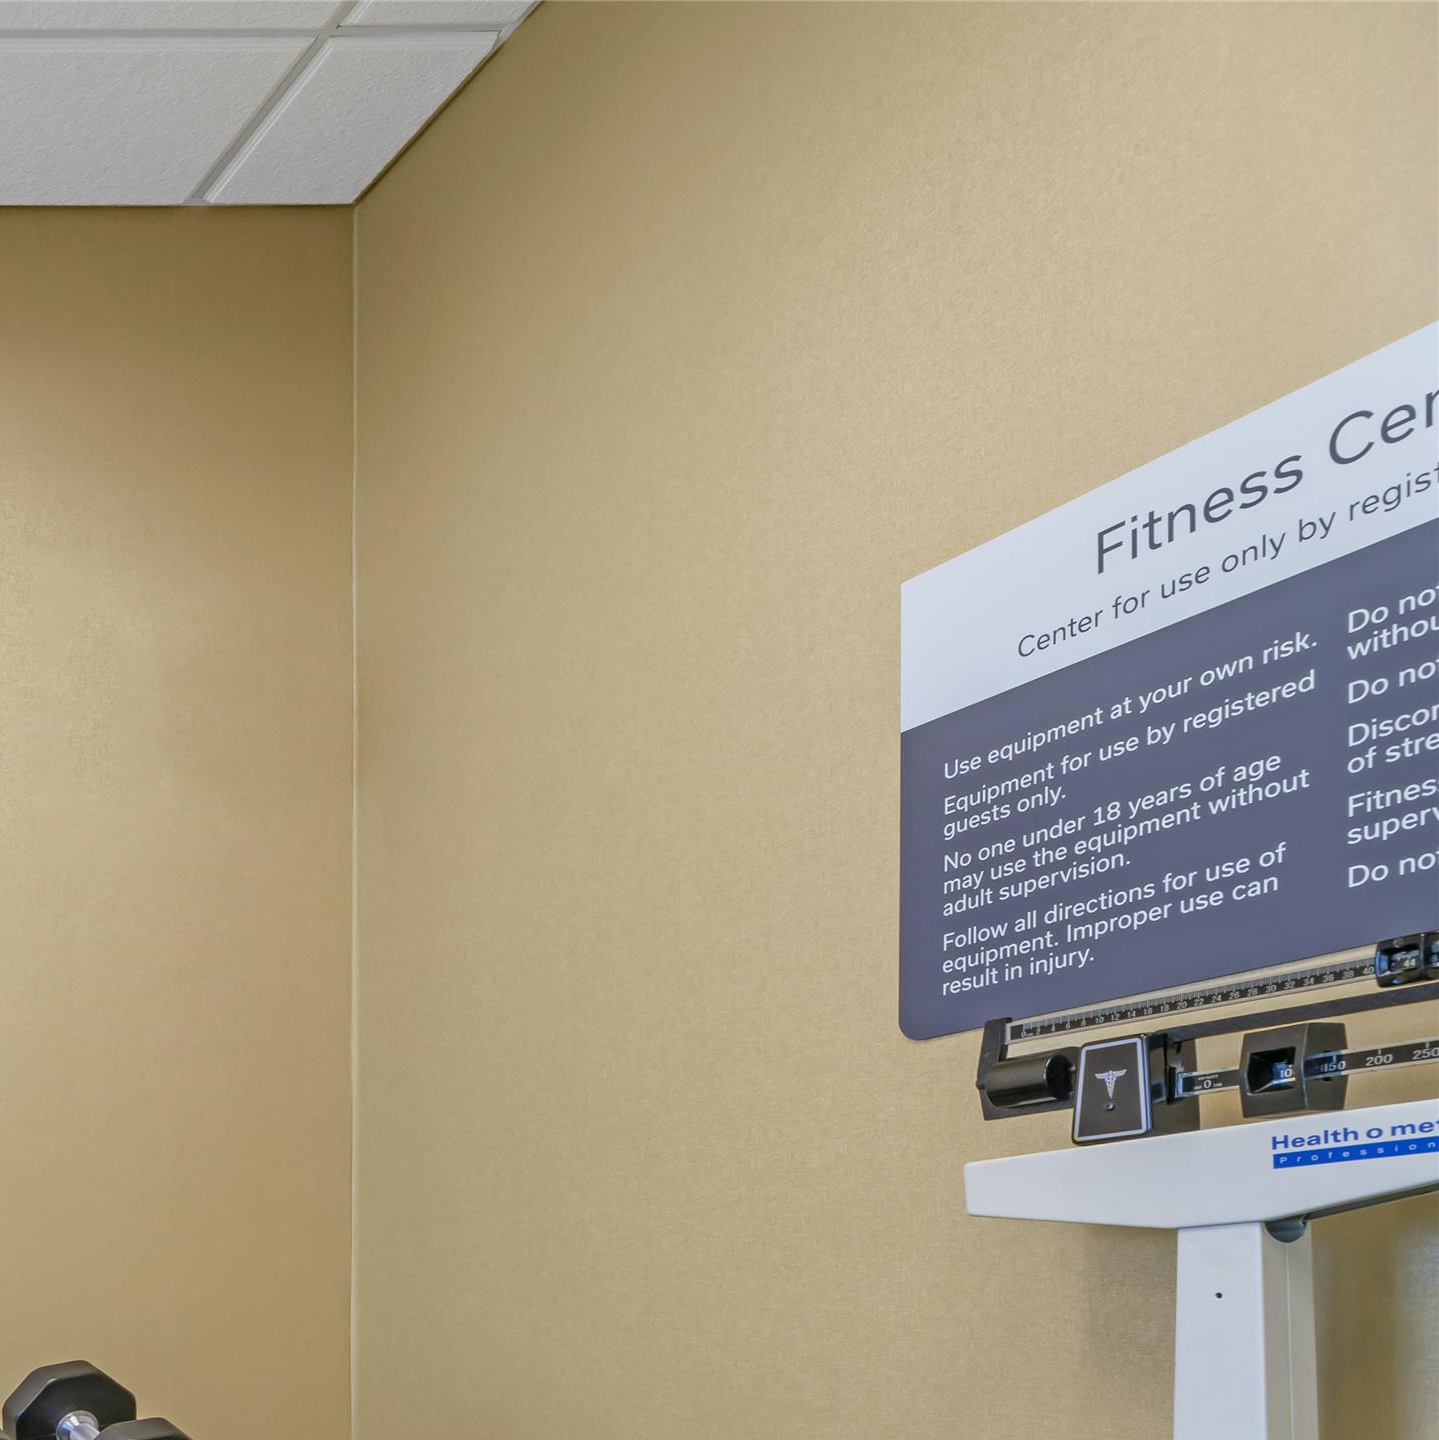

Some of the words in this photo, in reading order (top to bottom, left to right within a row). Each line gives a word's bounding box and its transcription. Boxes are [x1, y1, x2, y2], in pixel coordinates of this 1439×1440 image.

[1097, 453, 1303, 575] Fitness
[1018, 609, 1103, 658] Center
[1113, 587, 1150, 619] for
[1161, 566, 1211, 600] use
[1222, 532, 1286, 573] only
[1299, 510, 1336, 543] by
[1348, 607, 1389, 633] Do
[1399, 585, 1439, 615] no
[944, 756, 981, 779] Use
[988, 708, 1103, 764] equipment
[1110, 696, 1131, 719] at
[1138, 677, 1192, 712] your
[1200, 656, 1253, 686] own
[1263, 630, 1318, 664] risk.
[1348, 678, 1389, 704] Do
[1399, 658, 1439, 687] no
[944, 762, 1054, 814] Equipment
[1061, 752, 1092, 775] for
[1100, 734, 1139, 762] use
[1147, 722, 1175, 747] by
[1183, 670, 1315, 734] registered
[1347, 746, 1377, 773] of
[943, 805, 1011, 840] guests
[1017, 784, 1066, 815] only.
[944, 852, 971, 872] No
[978, 838, 1016, 861] one
[1023, 813, 1085, 848] under
[1093, 802, 1120, 827] 18
[1128, 781, 1192, 819] years
[1200, 766, 1225, 792] of
[1233, 755, 1281, 787] age
[1348, 778, 1439, 817] Fitnes
[944, 869, 984, 894] may
[991, 856, 1026, 881] use
[1033, 845, 1067, 868] the
[1074, 800, 1201, 854] equipment
[1209, 769, 1310, 814] without
[943, 888, 993, 916] adult
[999, 853, 1130, 901] supervision.
[943, 922, 1008, 951] Follow
[1014, 911, 1036, 932] all
[1044, 882, 1155, 924] directions
[1162, 869, 1198, 893] for
[1206, 855, 1250, 882] use
[1259, 842, 1288, 868] of
[1348, 865, 1389, 888] Do
[1399, 851, 1439, 875] no
[943, 932, 1058, 974] equipment.
[1067, 902, 1172, 946] Improper
[1180, 888, 1223, 914] use
[1232, 875, 1278, 901] can
[943, 967, 998, 996] result
[1005, 958, 1022, 982] in
[1030, 946, 1094, 978] injury.
[1365, 1053, 1393, 1067] 200
[1272, 1127, 1359, 1150] Health
[1391, 1120, 1439, 1137] me
